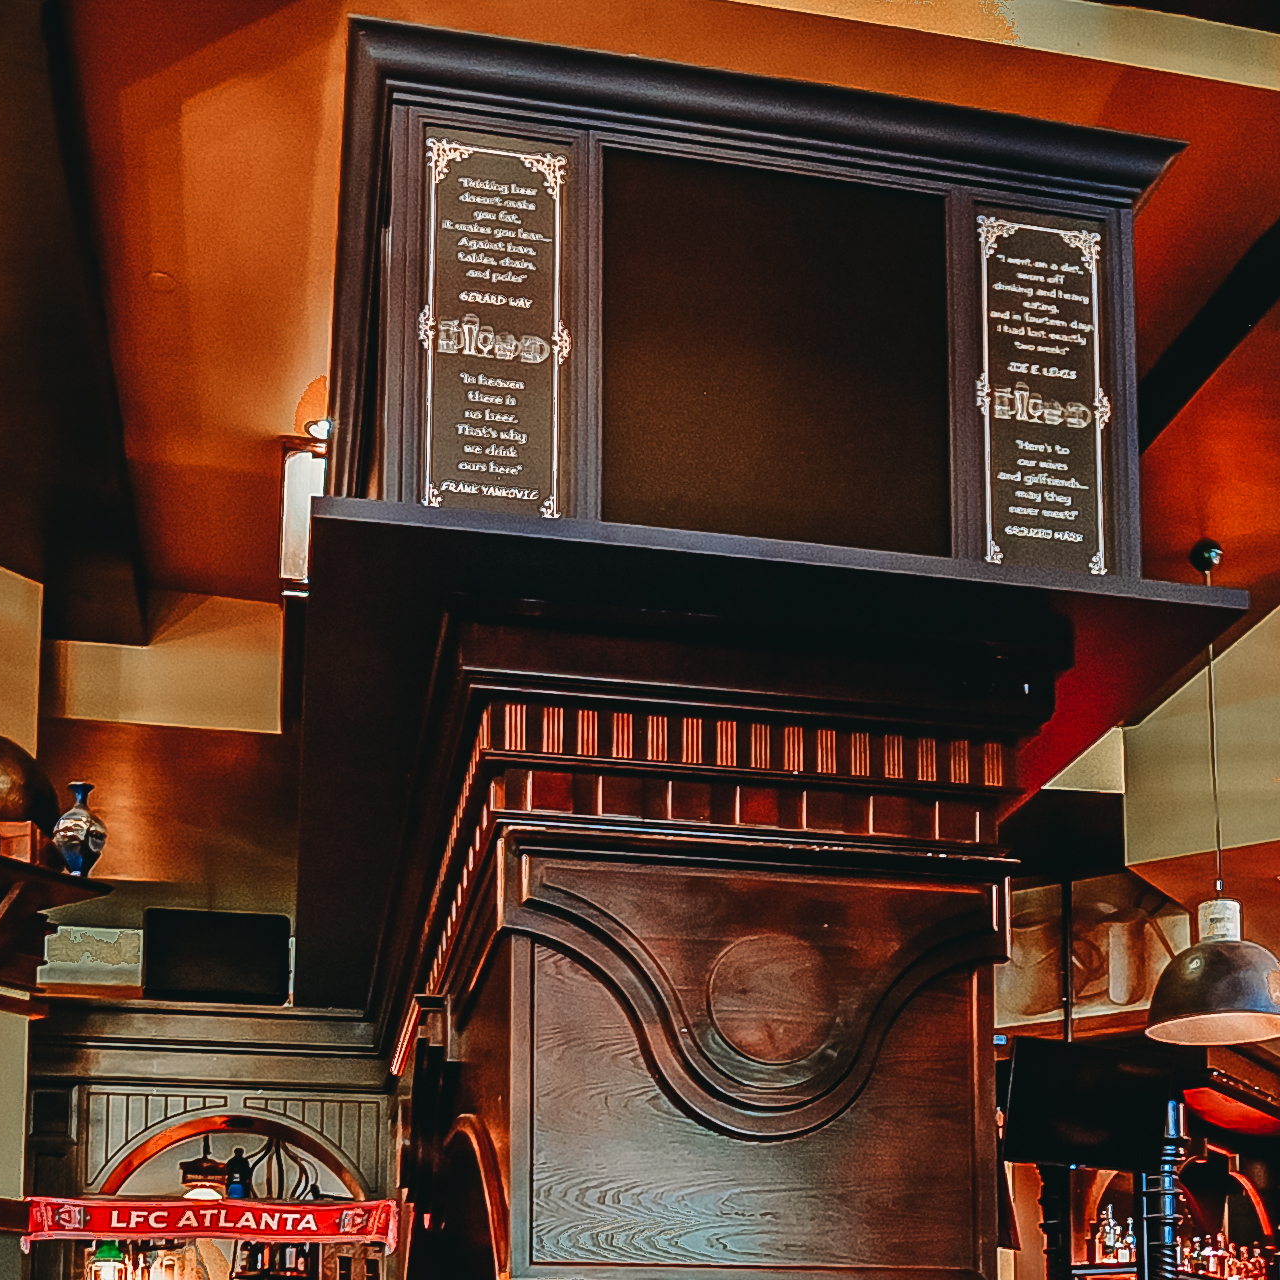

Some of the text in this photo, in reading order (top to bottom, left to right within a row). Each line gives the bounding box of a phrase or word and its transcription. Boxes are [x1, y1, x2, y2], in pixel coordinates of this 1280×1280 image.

[466, 268, 491, 280] and
[458, 290, 533, 308] GERARD WAY
[1036, 288, 1057, 298] and
[990, 310, 1010, 320] and
[478, 374, 526, 390] heaven
[467, 390, 504, 404] there
[499, 428, 528, 444] why
[484, 444, 518, 458] drink
[458, 461, 488, 472] ours
[440, 480, 540, 500] FRANK YANKOVIC
[110, 1208, 318, 1232] LFC ATLANTA
